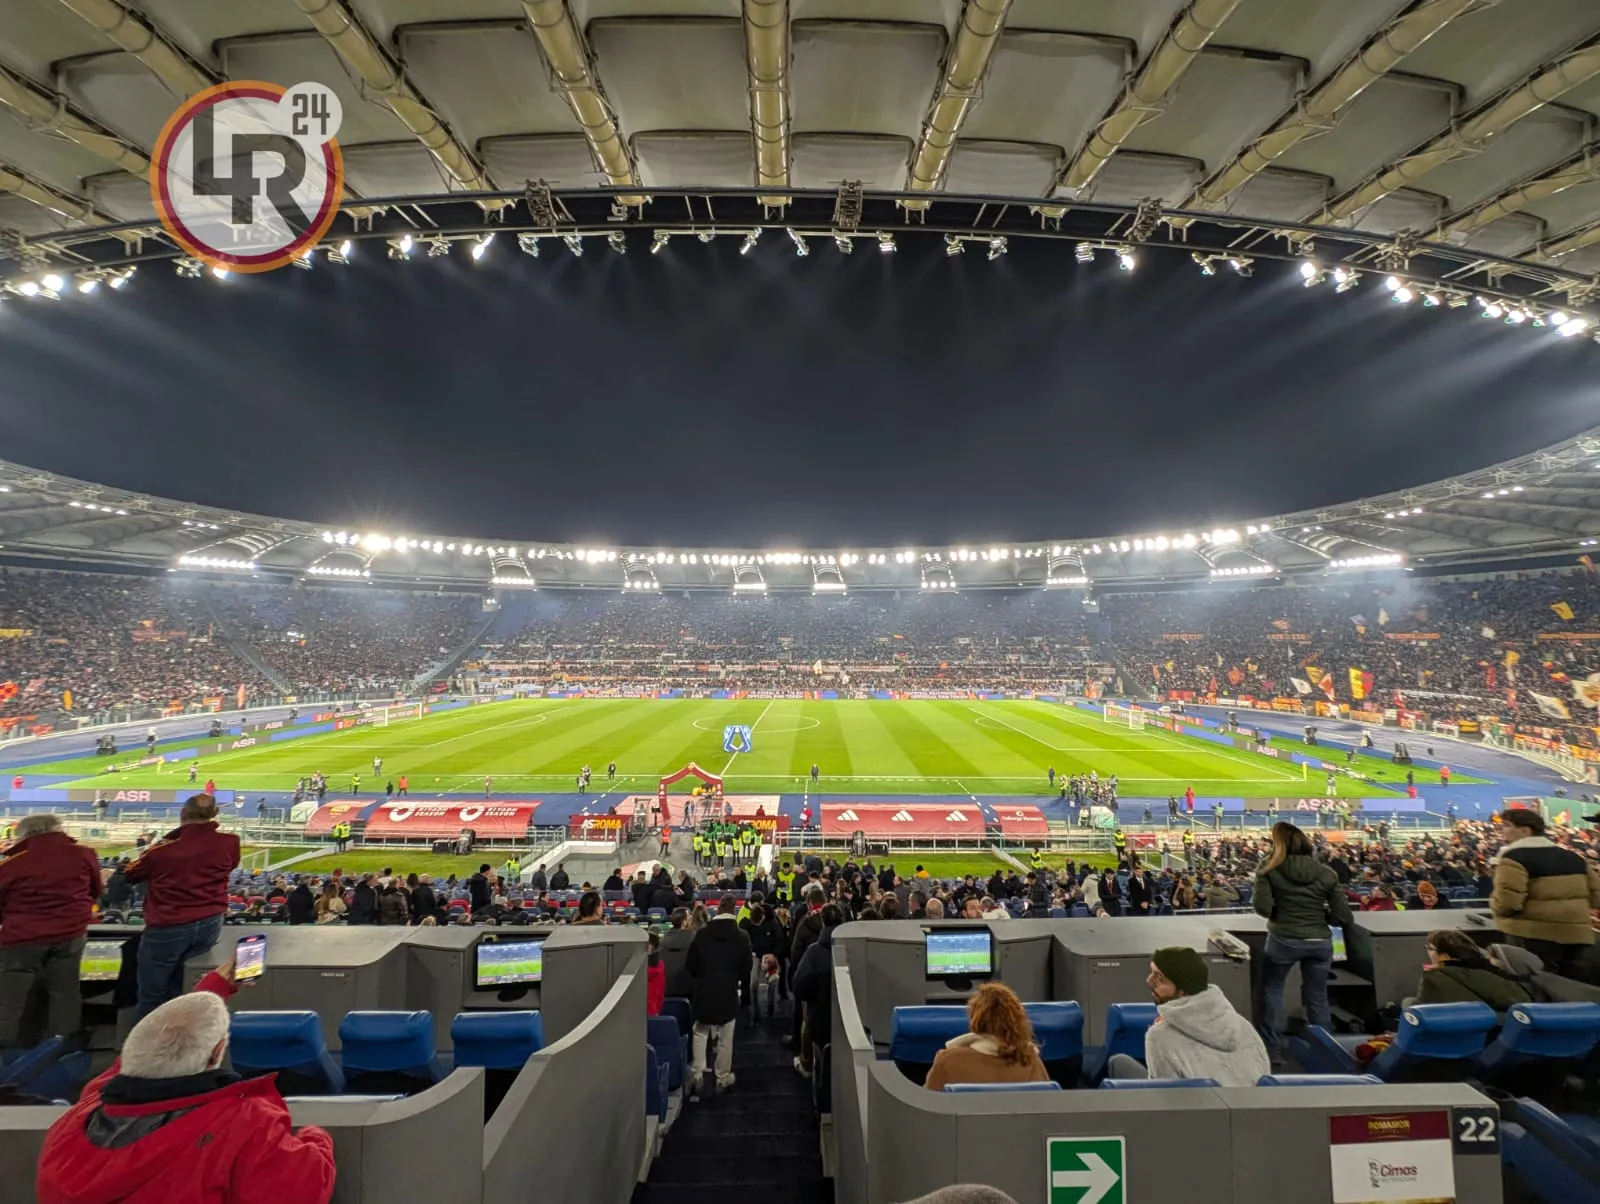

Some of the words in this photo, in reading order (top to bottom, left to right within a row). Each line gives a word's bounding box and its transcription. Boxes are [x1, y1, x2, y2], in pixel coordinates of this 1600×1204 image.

[231, 738, 256, 750] ASR
[1256, 745, 1279, 758] ASR
[113, 790, 150, 802] ASR
[1459, 1116, 1497, 1142] 22
[1380, 1163, 1418, 1178] Cimas
